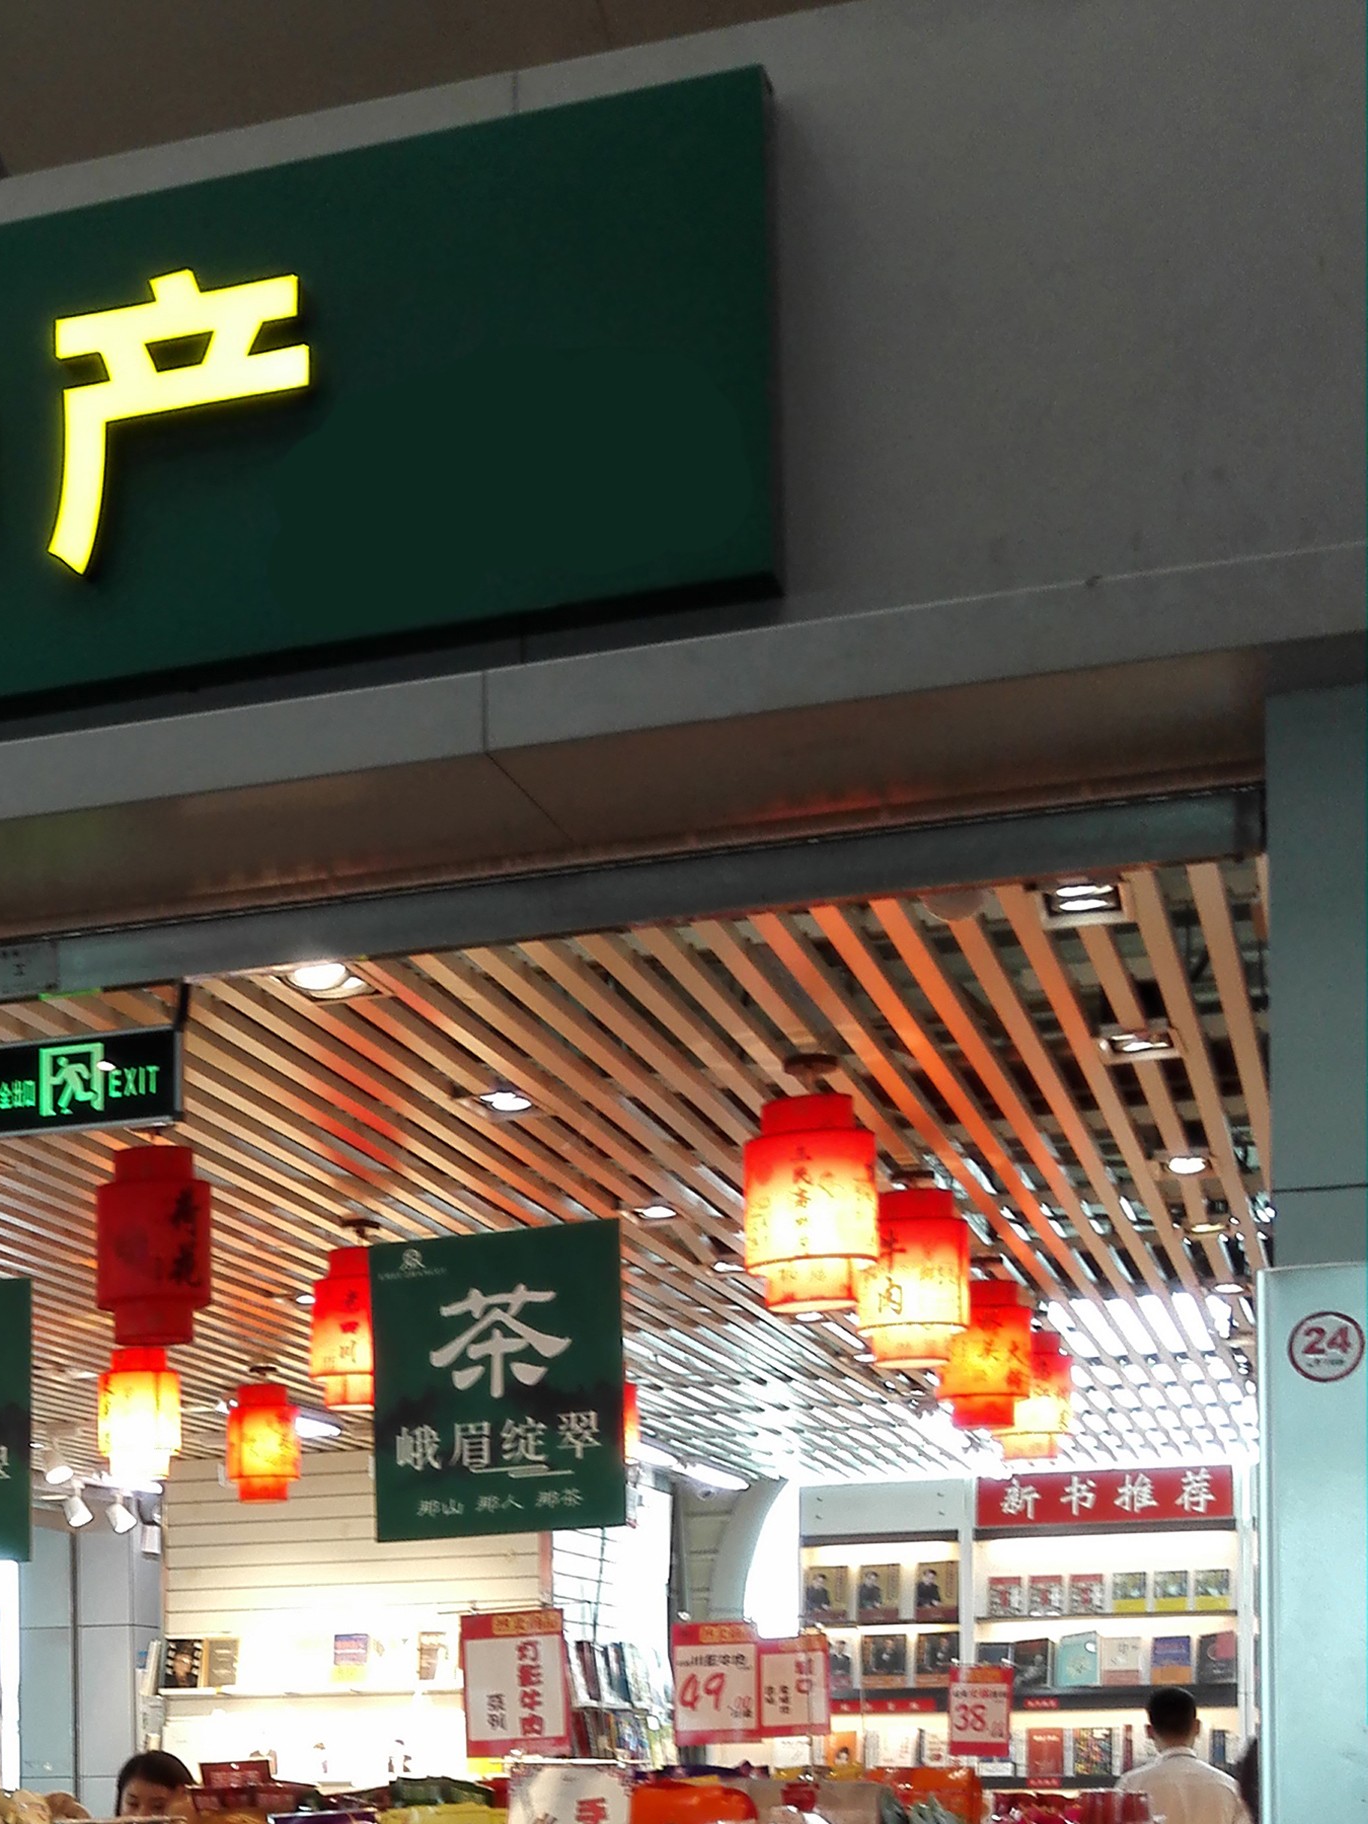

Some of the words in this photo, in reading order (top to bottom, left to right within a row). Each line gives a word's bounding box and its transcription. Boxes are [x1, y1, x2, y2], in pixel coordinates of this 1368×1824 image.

[108, 1065, 160, 1098] EXIT
[430, 1283, 572, 1399] 茶
[1302, 1326, 1351, 1354] 24
[395, 1410, 602, 1472] 峨眉绽翠
[999, 1467, 1218, 1520] 新书推荐
